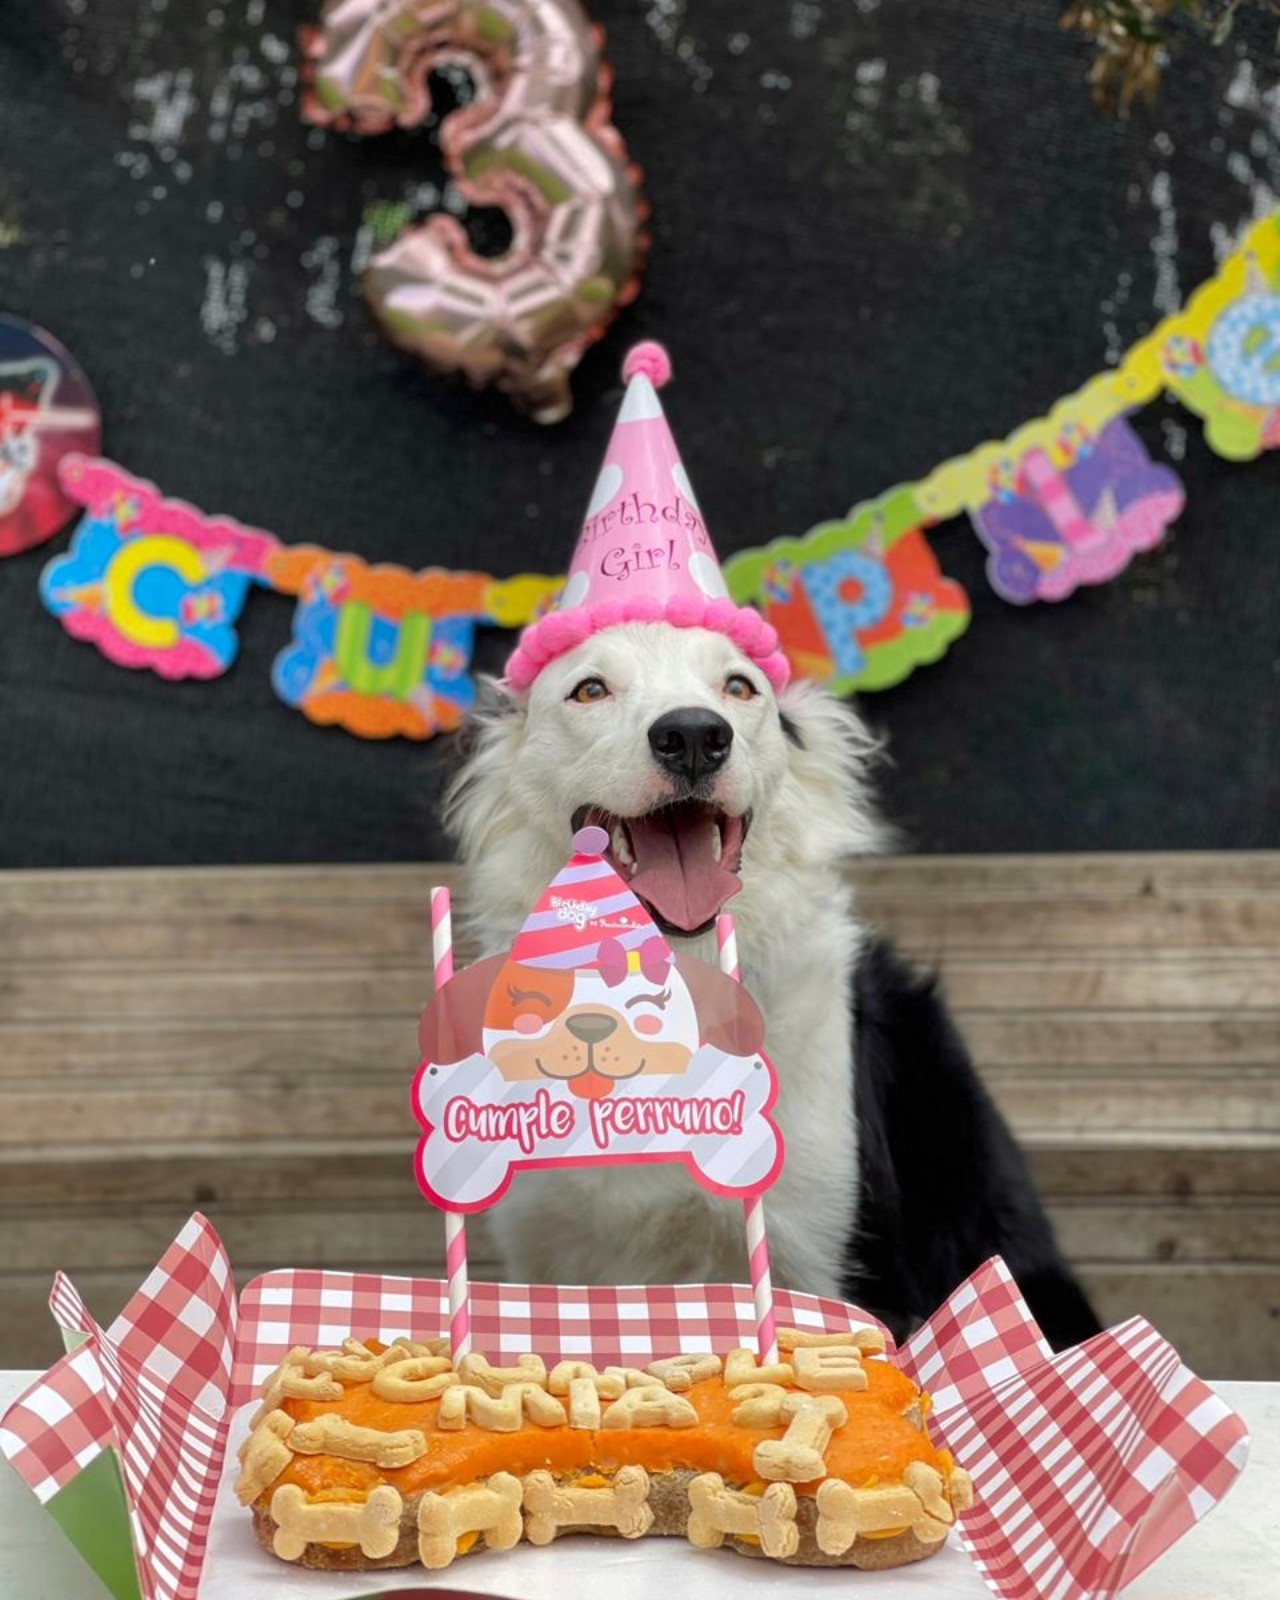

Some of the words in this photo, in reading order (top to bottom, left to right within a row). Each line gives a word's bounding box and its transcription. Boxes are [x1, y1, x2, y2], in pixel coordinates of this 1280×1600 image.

[298, 0, 650, 424] 3
[582, 493, 708, 545] irthday
[601, 539, 680, 581] Girl
[559, 906, 585, 932] dog
[444, 1088, 576, 1154] Cumple
[589, 1089, 746, 1149] perruno!
